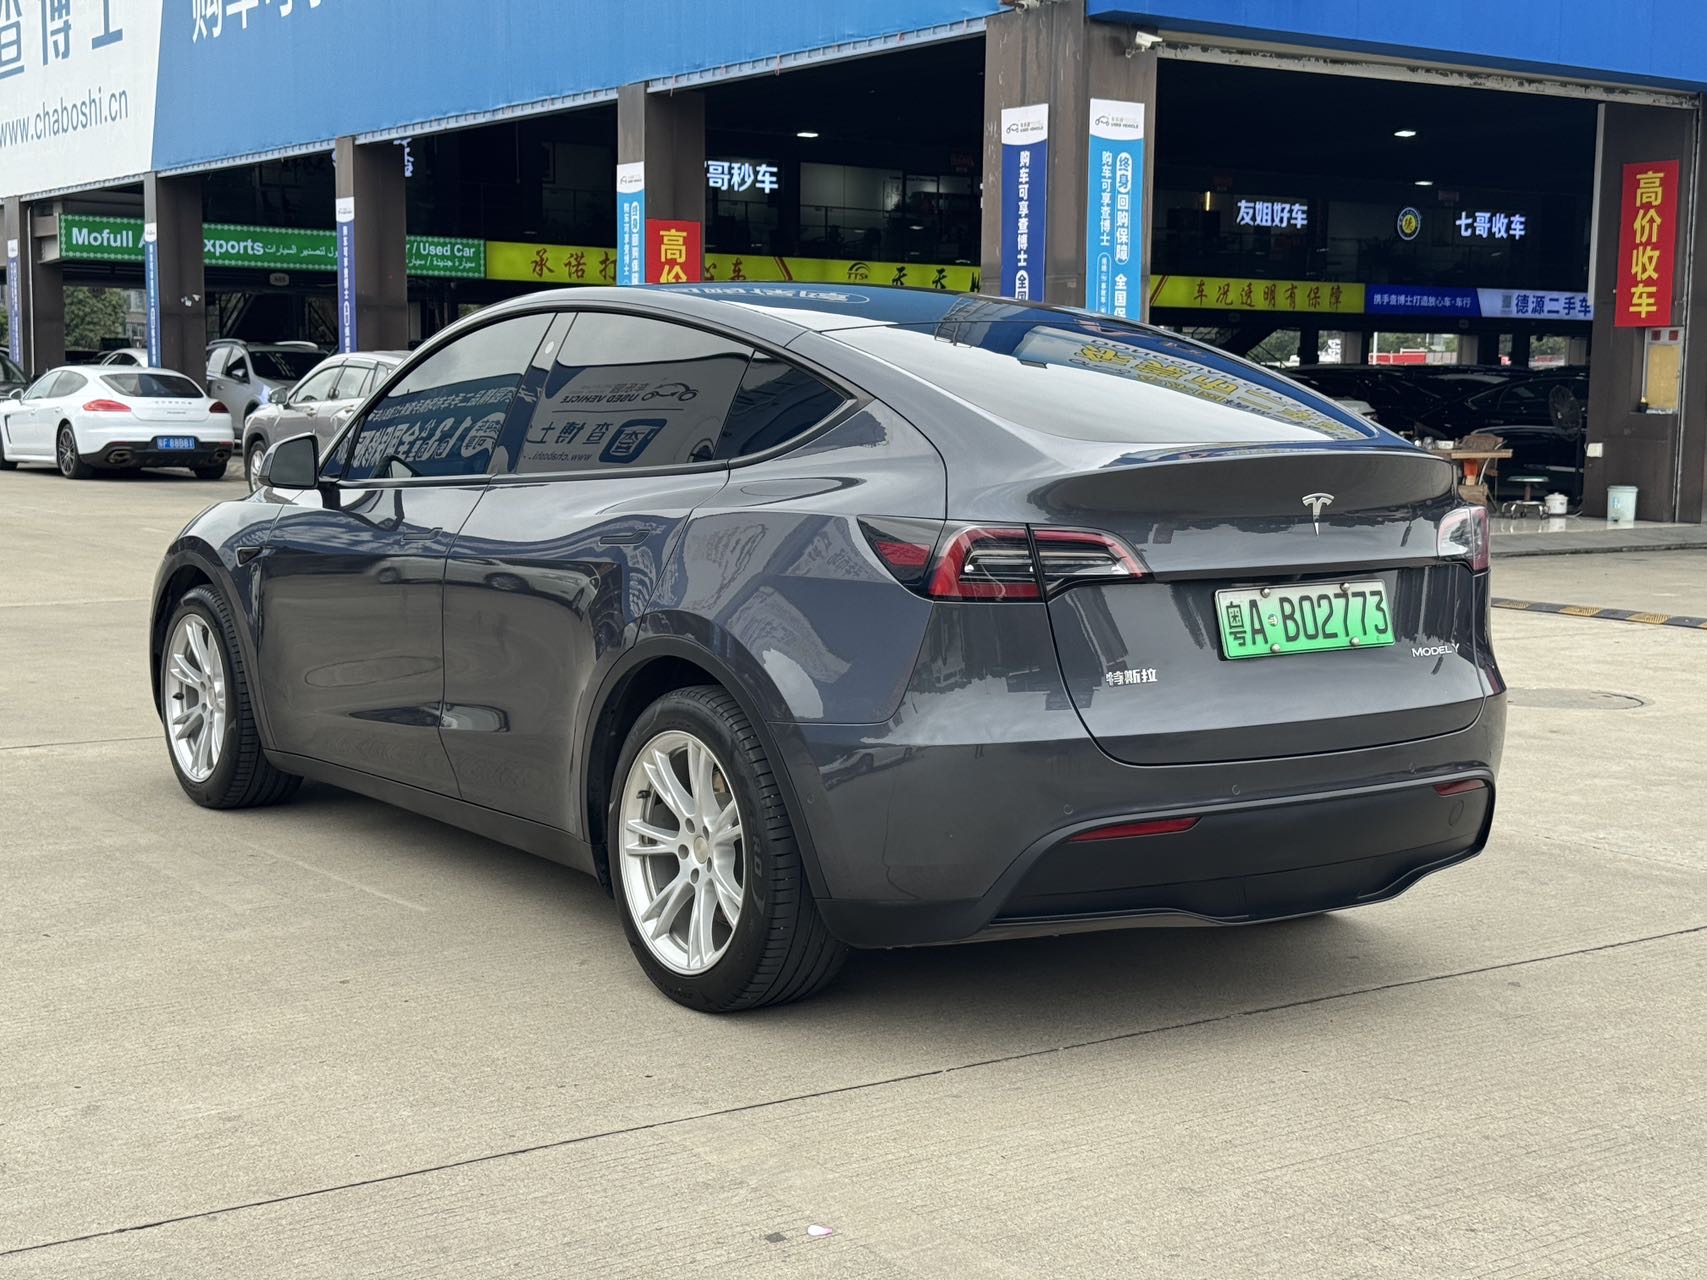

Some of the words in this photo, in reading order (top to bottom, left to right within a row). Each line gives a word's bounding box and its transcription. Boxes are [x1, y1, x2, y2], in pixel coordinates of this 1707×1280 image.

[0, 86, 128, 148] www.chaboshi.cn
[704, 160, 779, 194] 哥秒车
[1017, 151, 1030, 267] 购车可享查博士
[1100, 151, 1113, 247] 购车可享查博士
[1237, 200, 1308, 229] 友姐好车
[1456, 211, 1526, 240] 七哥收车
[72, 227, 133, 249] Mofull
[203, 238, 264, 257] xports
[420, 242, 451, 256] Used
[454, 244, 476, 257] Car
[1629, 170, 1665, 318] 高价收车
[1194, 280, 1343, 312] 车况透明有保障
[1515, 294, 1591, 317] 德源二手车
[1411, 645, 1452, 657] MODEL
[1452, 643, 1459, 652] Y
[1105, 668, 1158, 686] 特斯拉
